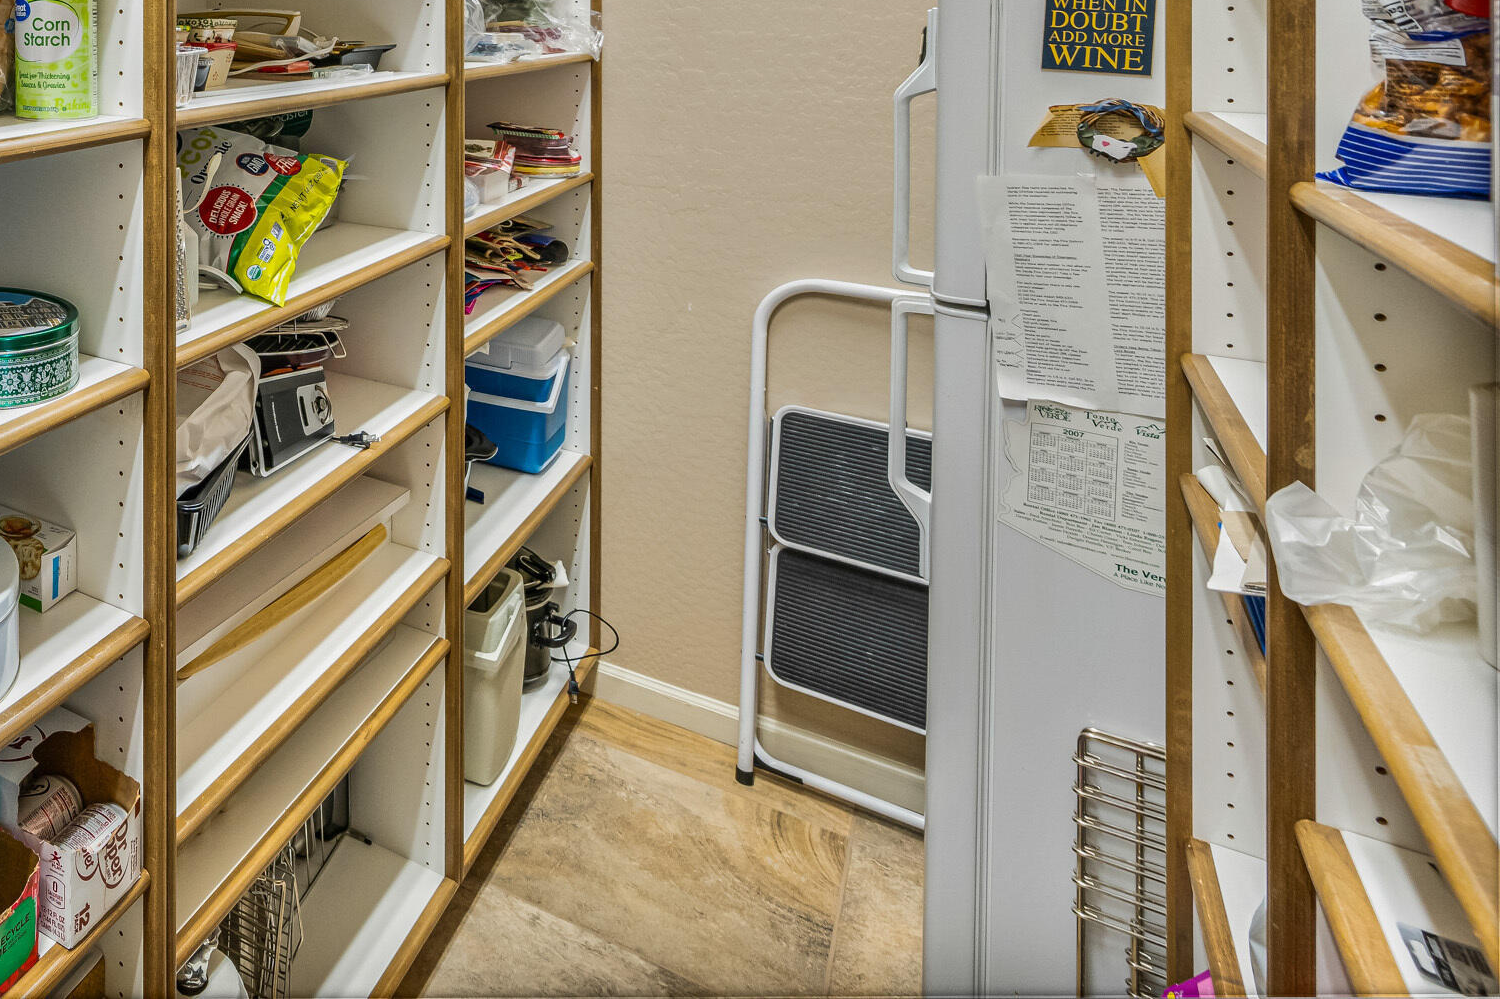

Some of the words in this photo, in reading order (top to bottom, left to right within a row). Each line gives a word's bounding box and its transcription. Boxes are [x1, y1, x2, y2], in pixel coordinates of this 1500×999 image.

[32, 17, 70, 32] Corn
[1050, 9, 1148, 33] DOUBT
[24, 32, 71, 47] Starch
[1049, 30, 1087, 43] ADD
[1092, 32, 1146, 47] MORE
[1048, 43, 1144, 71] WINE
[248, 157, 265, 173] GMO
[208, 190, 232, 224] DELICIOUS
[218, 208, 230, 226] WHOLE
[228, 193, 241, 210] GRAIN
[229, 201, 248, 225] SNACK!
[1063, 428, 1085, 438] 2007
[1136, 428, 1160, 440] Vista
[1115, 563, 1138, 576] The
[1120, 573, 1138, 584] Place
[79, 902, 91, 932] 12
